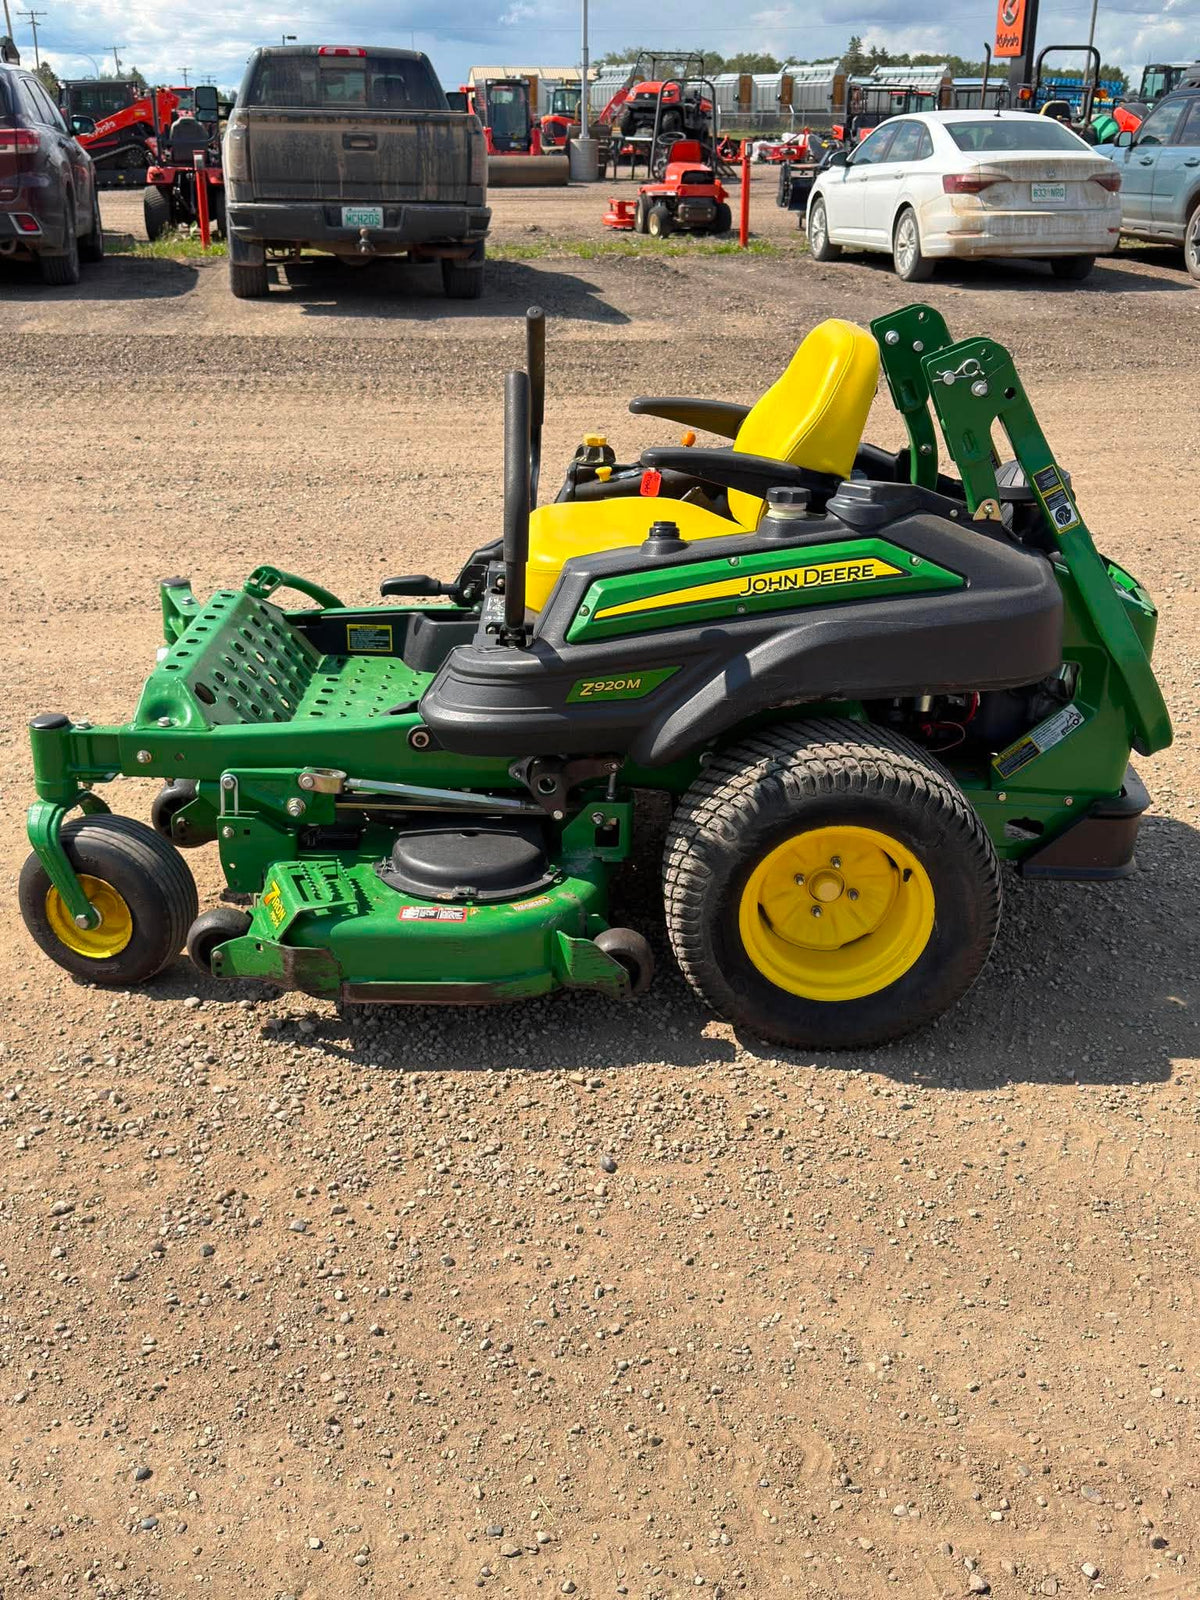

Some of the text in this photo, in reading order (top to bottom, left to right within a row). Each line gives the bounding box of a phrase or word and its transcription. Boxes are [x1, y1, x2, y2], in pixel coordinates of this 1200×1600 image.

[740, 564, 875, 595] JOHN DEERE
[579, 679, 641, 696] Z920M
